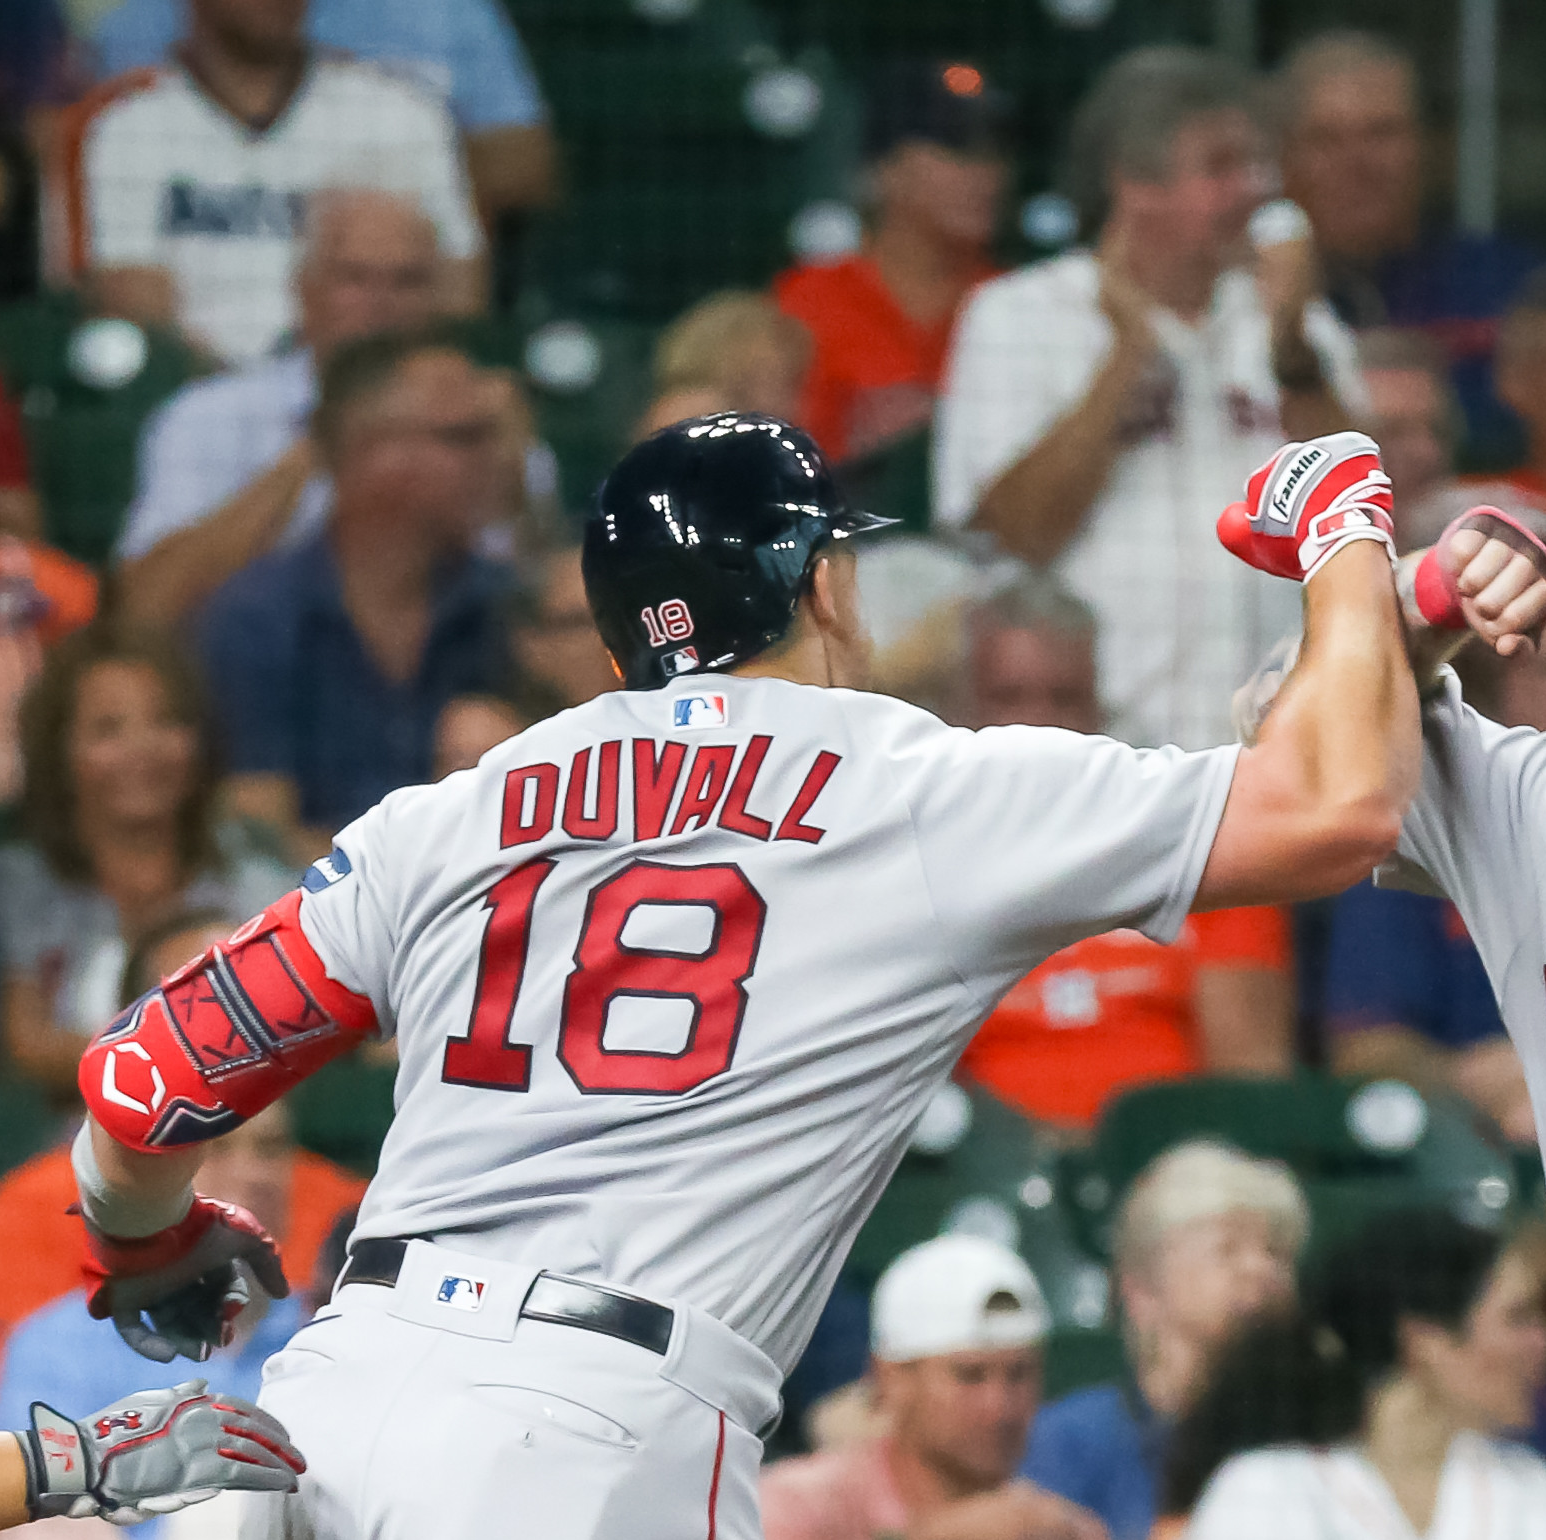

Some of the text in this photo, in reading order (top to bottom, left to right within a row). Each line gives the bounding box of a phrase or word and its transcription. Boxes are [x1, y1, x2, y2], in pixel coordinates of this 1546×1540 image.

[641, 598, 695, 648] 18
[500, 735, 843, 850] DUVALL
[441, 857, 768, 1096] 18
